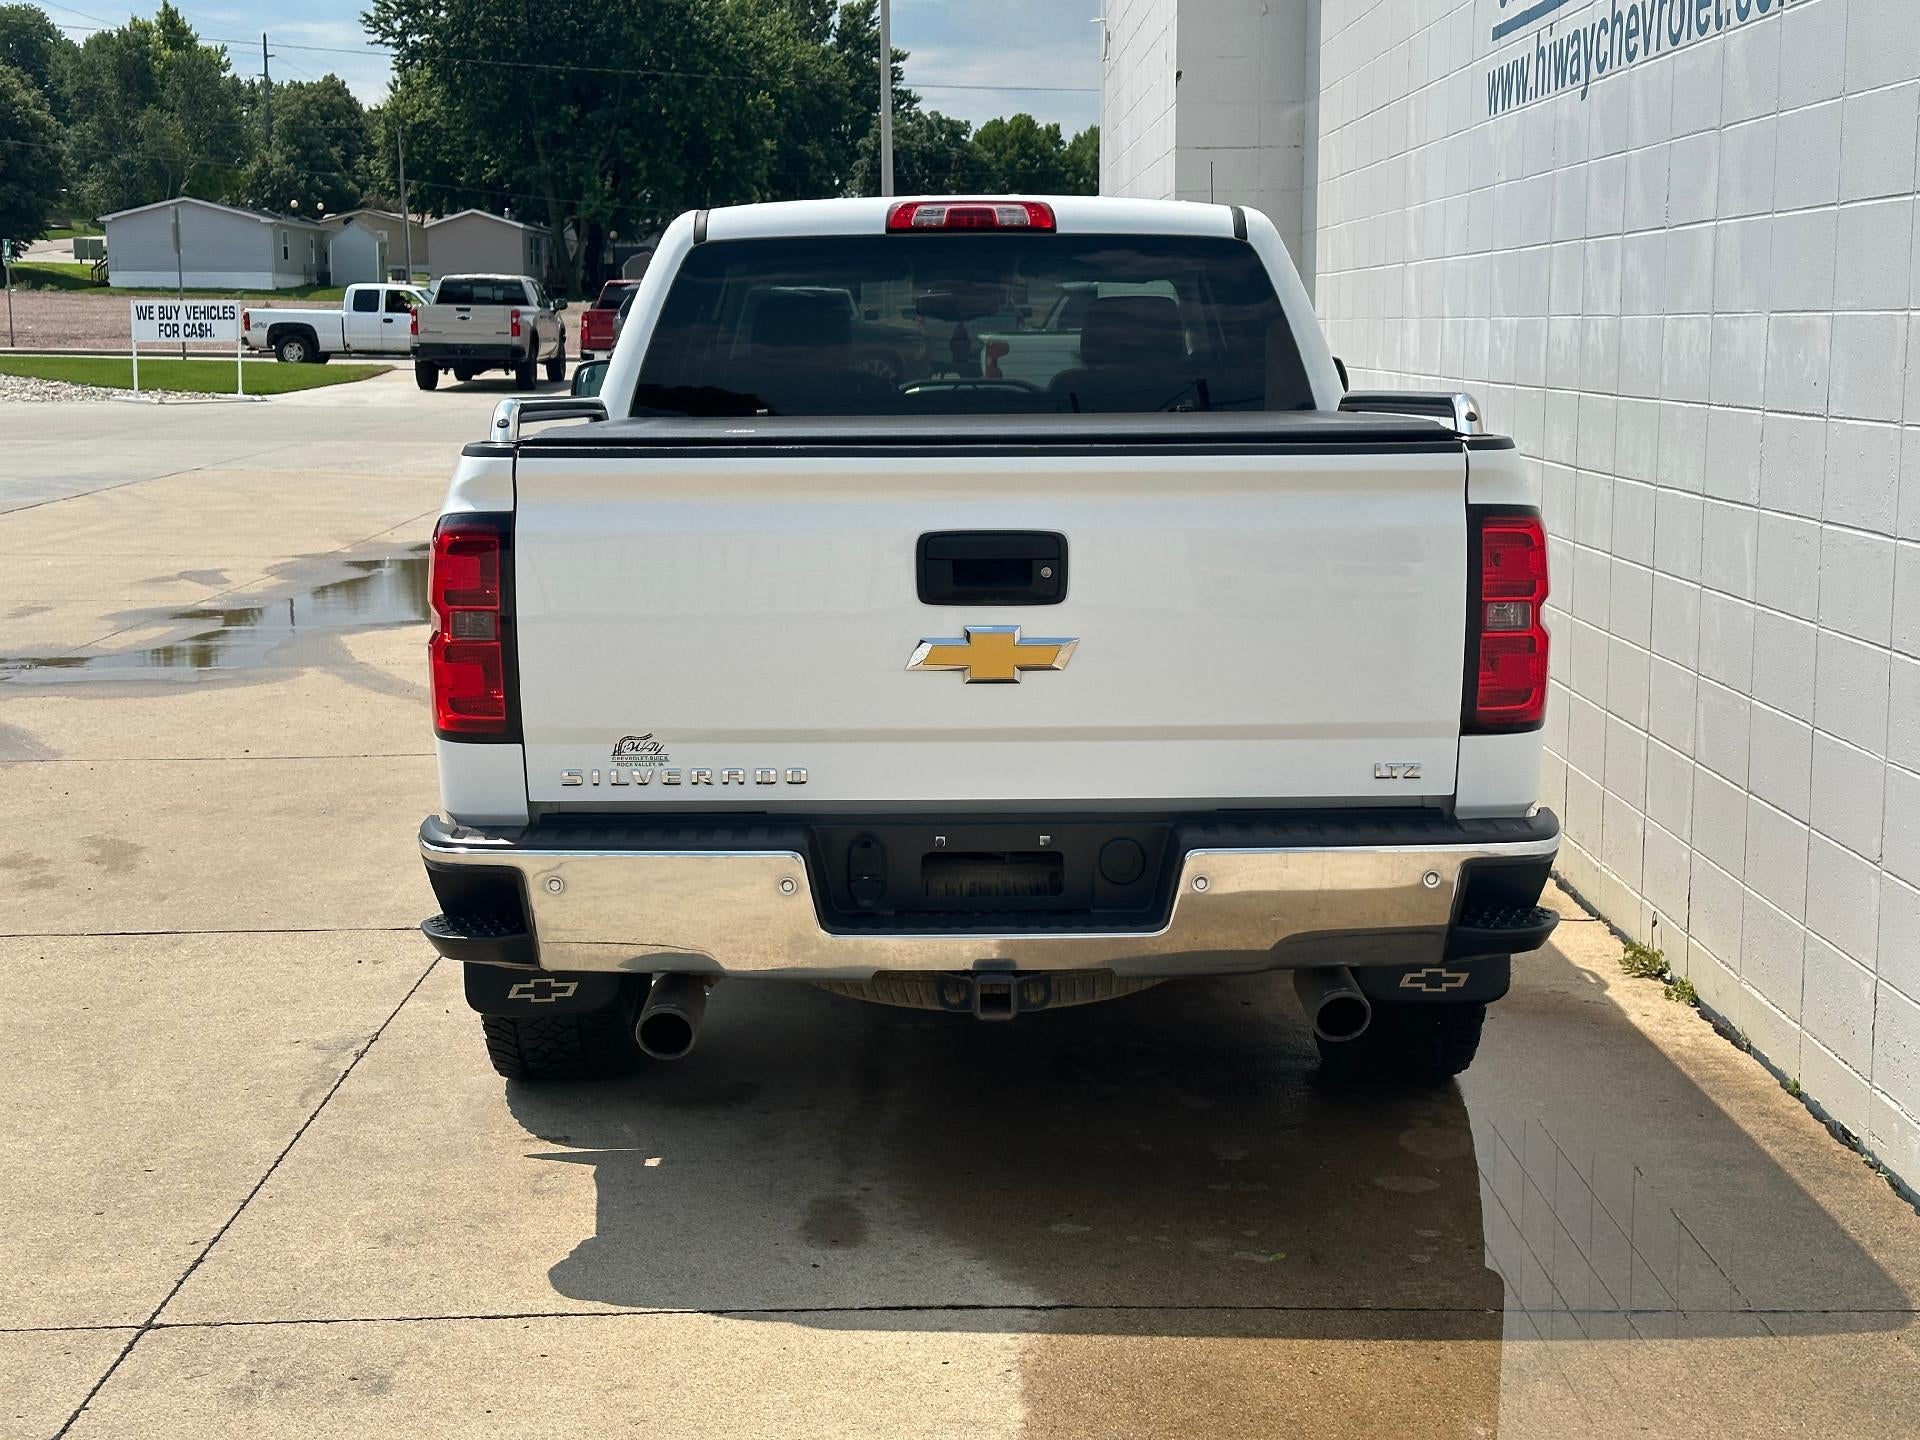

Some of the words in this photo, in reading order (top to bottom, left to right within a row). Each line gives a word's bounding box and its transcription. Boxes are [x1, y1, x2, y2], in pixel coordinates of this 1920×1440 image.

[1487, 0, 1798, 117] www.hiwaychevroe.
[135, 305, 155, 320] WE
[158, 305, 181, 320] BUY
[185, 305, 236, 320] VEHICLES
[158, 323, 180, 338] FOR
[183, 322, 215, 339] CA$H.
[560, 767, 809, 786] SILVERADO
[1374, 763, 1423, 779] LTZ
